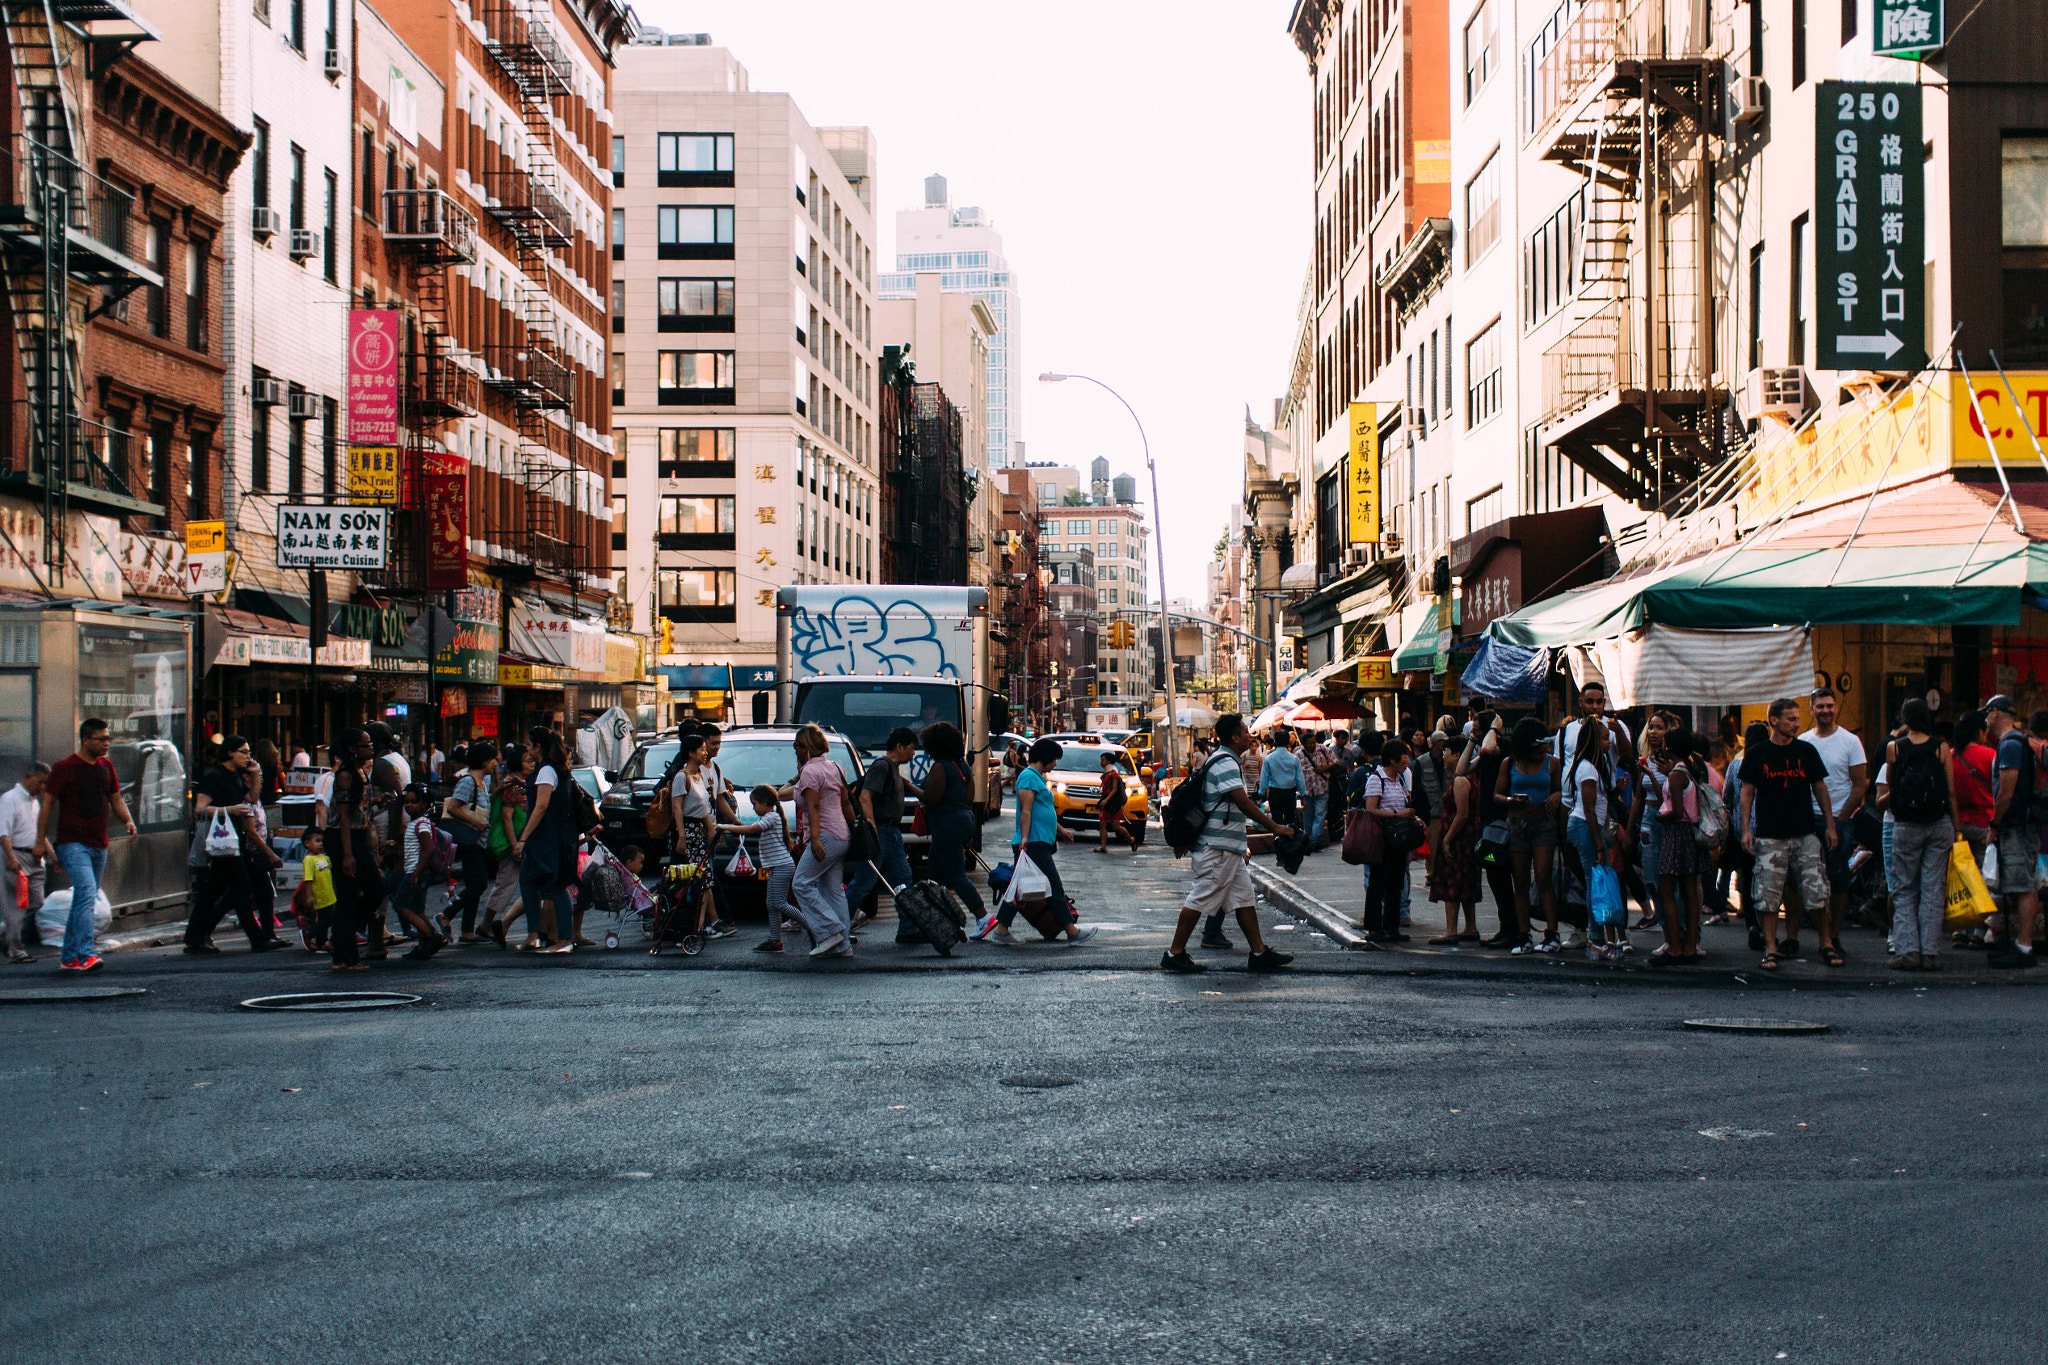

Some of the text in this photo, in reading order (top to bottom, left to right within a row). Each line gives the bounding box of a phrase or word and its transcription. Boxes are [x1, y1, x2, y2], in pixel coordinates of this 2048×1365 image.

[1883, 0, 1933, 48] 險
[1838, 92, 1900, 121] 250
[1836, 129, 1858, 322] GRAND ST
[1880, 133, 1905, 322] 格蘭街入口
[351, 374, 396, 388] 美容中心
[350, 389, 388, 401] Aroma
[355, 403, 396, 419] Beauty
[355, 421, 396, 433] 226-7213
[1355, 421, 1372, 524] 西醫梅一清
[370, 476, 394, 486] Travel
[283, 512, 331, 530] NAM
[187, 527, 212, 537] TURNING
[188, 540, 211, 550] VEHICLES
[283, 533, 380, 551] 南山越南餐館
[283, 552, 379, 567] Vietnamese Cuisine
[202, 569, 209, 577] TO
[281, 640, 300, 657] MARKET
